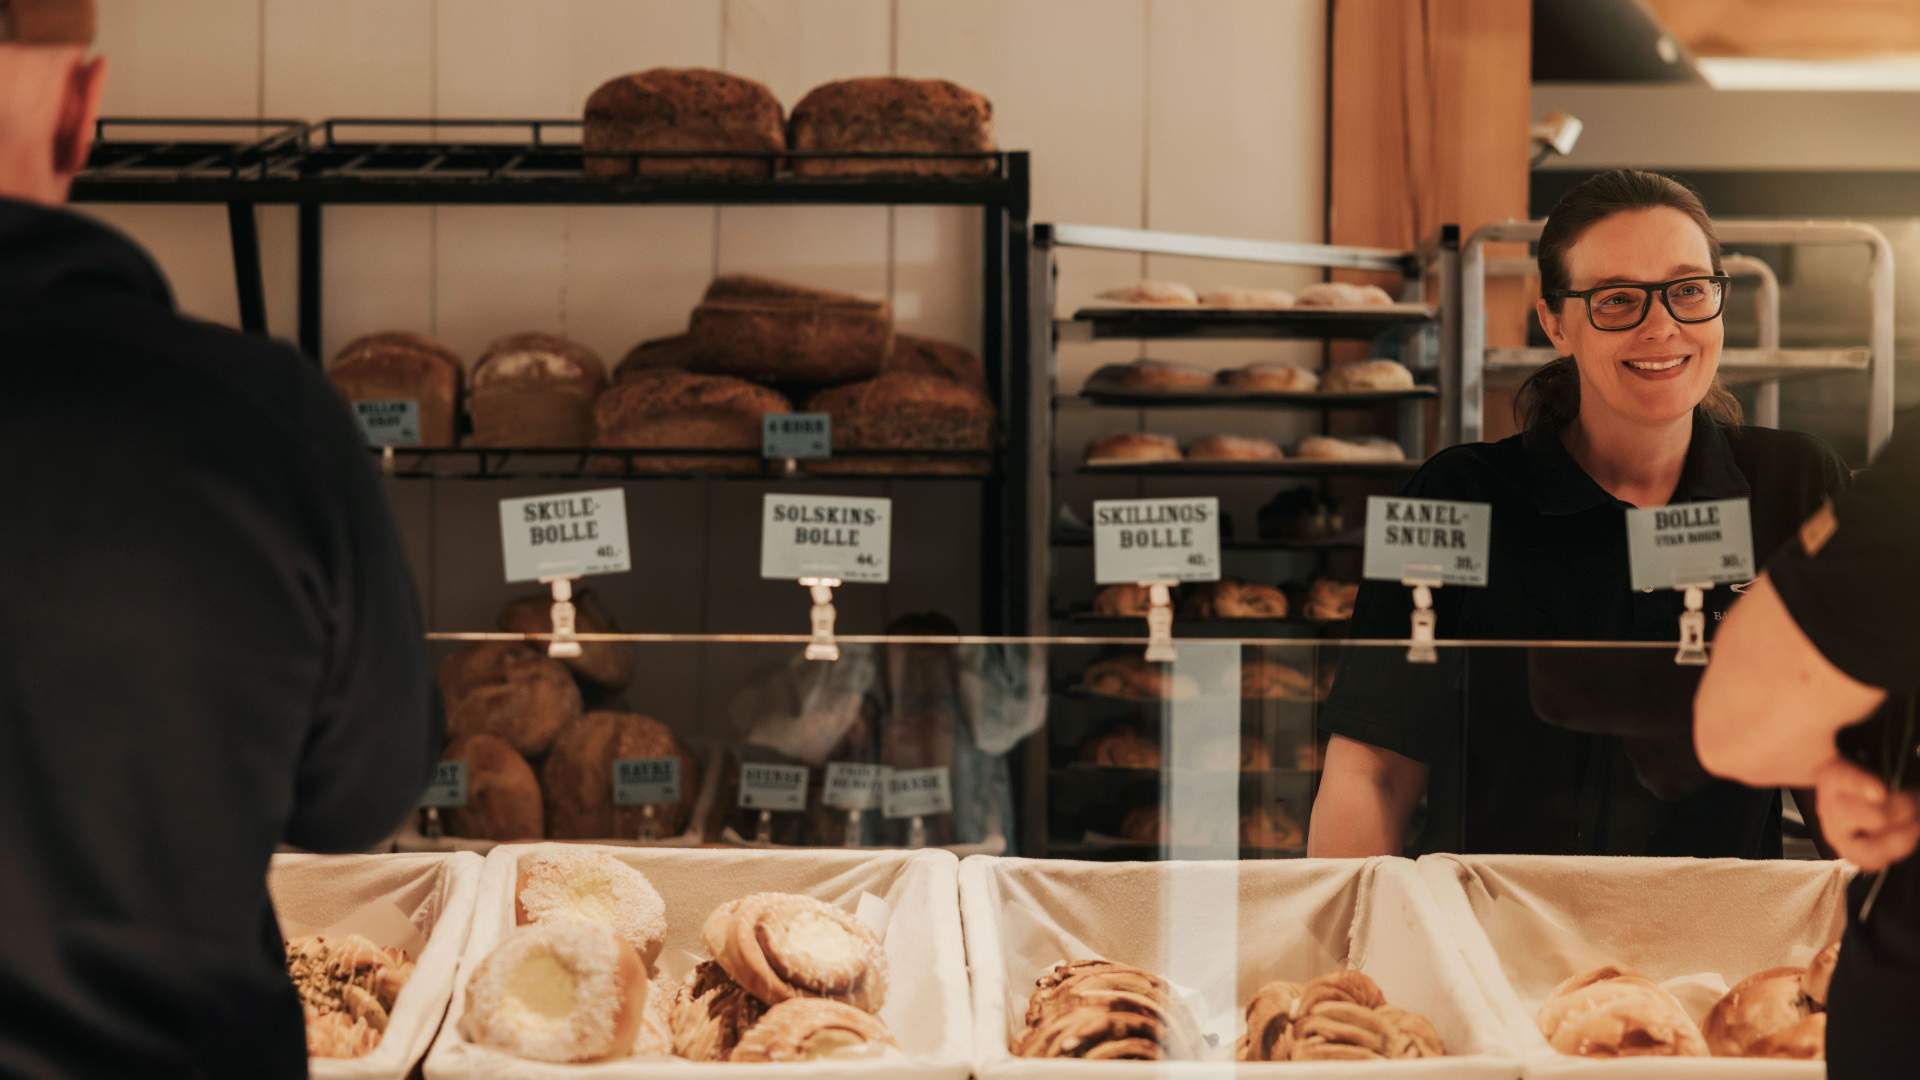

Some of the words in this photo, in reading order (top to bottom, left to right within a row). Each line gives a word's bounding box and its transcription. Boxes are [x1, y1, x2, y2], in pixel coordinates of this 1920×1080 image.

[523, 498, 601, 523] SKULE-
[773, 504, 883, 526] SOLSKINS-
[1098, 504, 1214, 526] SKILLINGS-
[1385, 502, 1470, 526] KANEL-
[1655, 506, 1720, 531] BOLLE
[529, 520, 599, 546] BOLLE
[794, 526, 860, 547] BOLLE
[1120, 528, 1193, 549] BOLLE
[1384, 525, 1467, 549] SNURR
